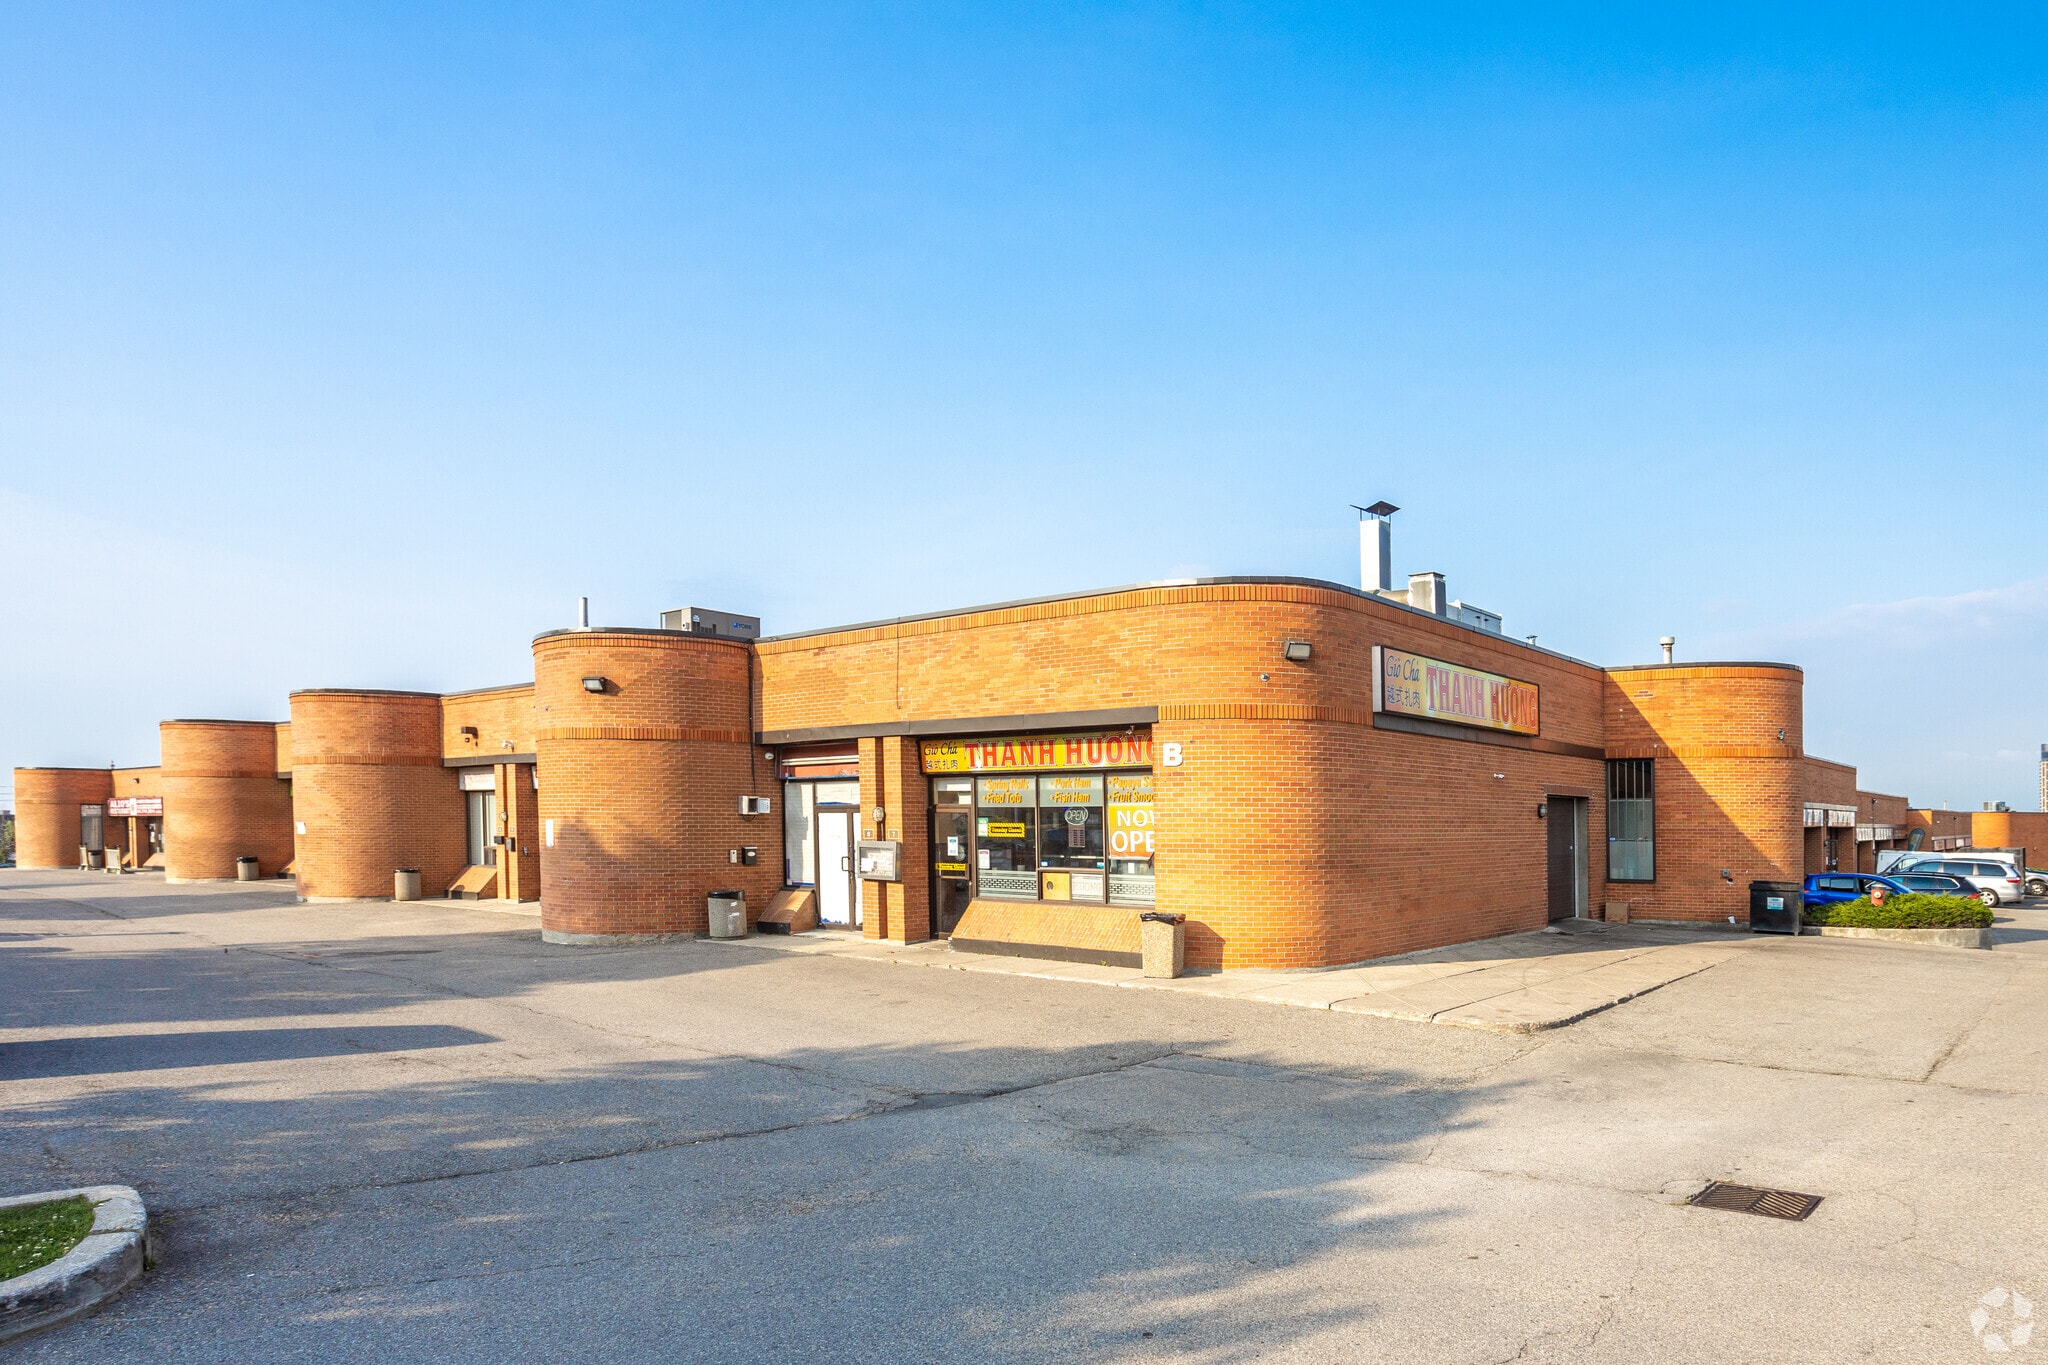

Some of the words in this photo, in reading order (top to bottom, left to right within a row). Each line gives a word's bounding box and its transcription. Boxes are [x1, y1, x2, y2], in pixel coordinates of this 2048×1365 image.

[1386, 655, 1401, 679] Giò
[1426, 664, 1486, 720] THANH
[1489, 681, 1537, 729] HƯƠNG
[964, 738, 1056, 769] THANH
[1163, 743, 1183, 767] B
[986, 778, 1009, 792] Spring
[1010, 778, 1029, 790] Rolls
[1054, 778, 1071, 789] Pork
[1073, 777, 1091, 788] Ham
[1112, 776, 1141, 790] Papaya
[987, 793, 1005, 804] Fried
[1006, 792, 1022, 804] Tofu
[1055, 792, 1071, 803] Fish
[1072, 792, 1090, 803] Ham
[1112, 791, 1131, 803] Fruit
[1066, 809, 1086, 821] OPEN
[1117, 810, 1155, 827] NO
